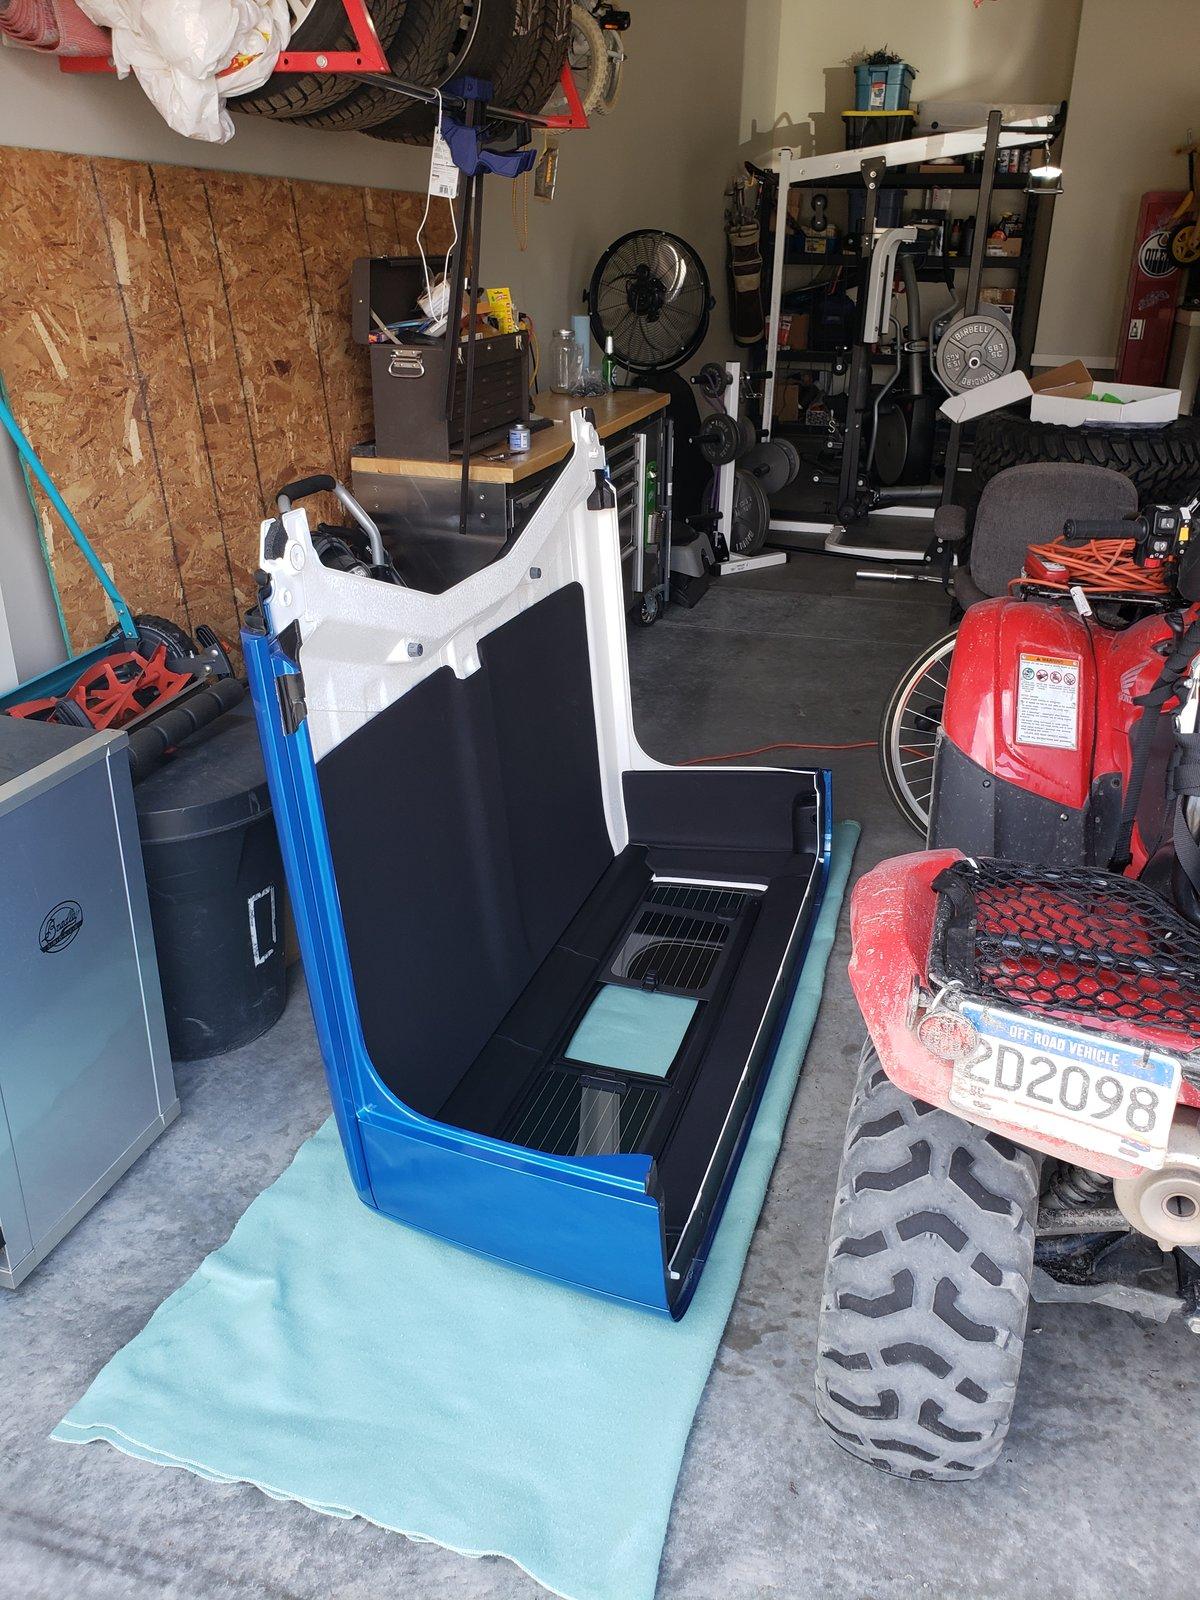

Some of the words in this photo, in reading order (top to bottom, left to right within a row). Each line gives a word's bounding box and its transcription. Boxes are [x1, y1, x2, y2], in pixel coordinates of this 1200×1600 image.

[955, 325, 988, 340] BARBELL
[961, 370, 996, 386] STANDARD
[1009, 1024, 1031, 1042] OFF
[1033, 1031, 1067, 1053] ROAD
[1069, 1041, 1121, 1067] VEHICLE
[963, 1037, 1160, 1133] 2D2098
